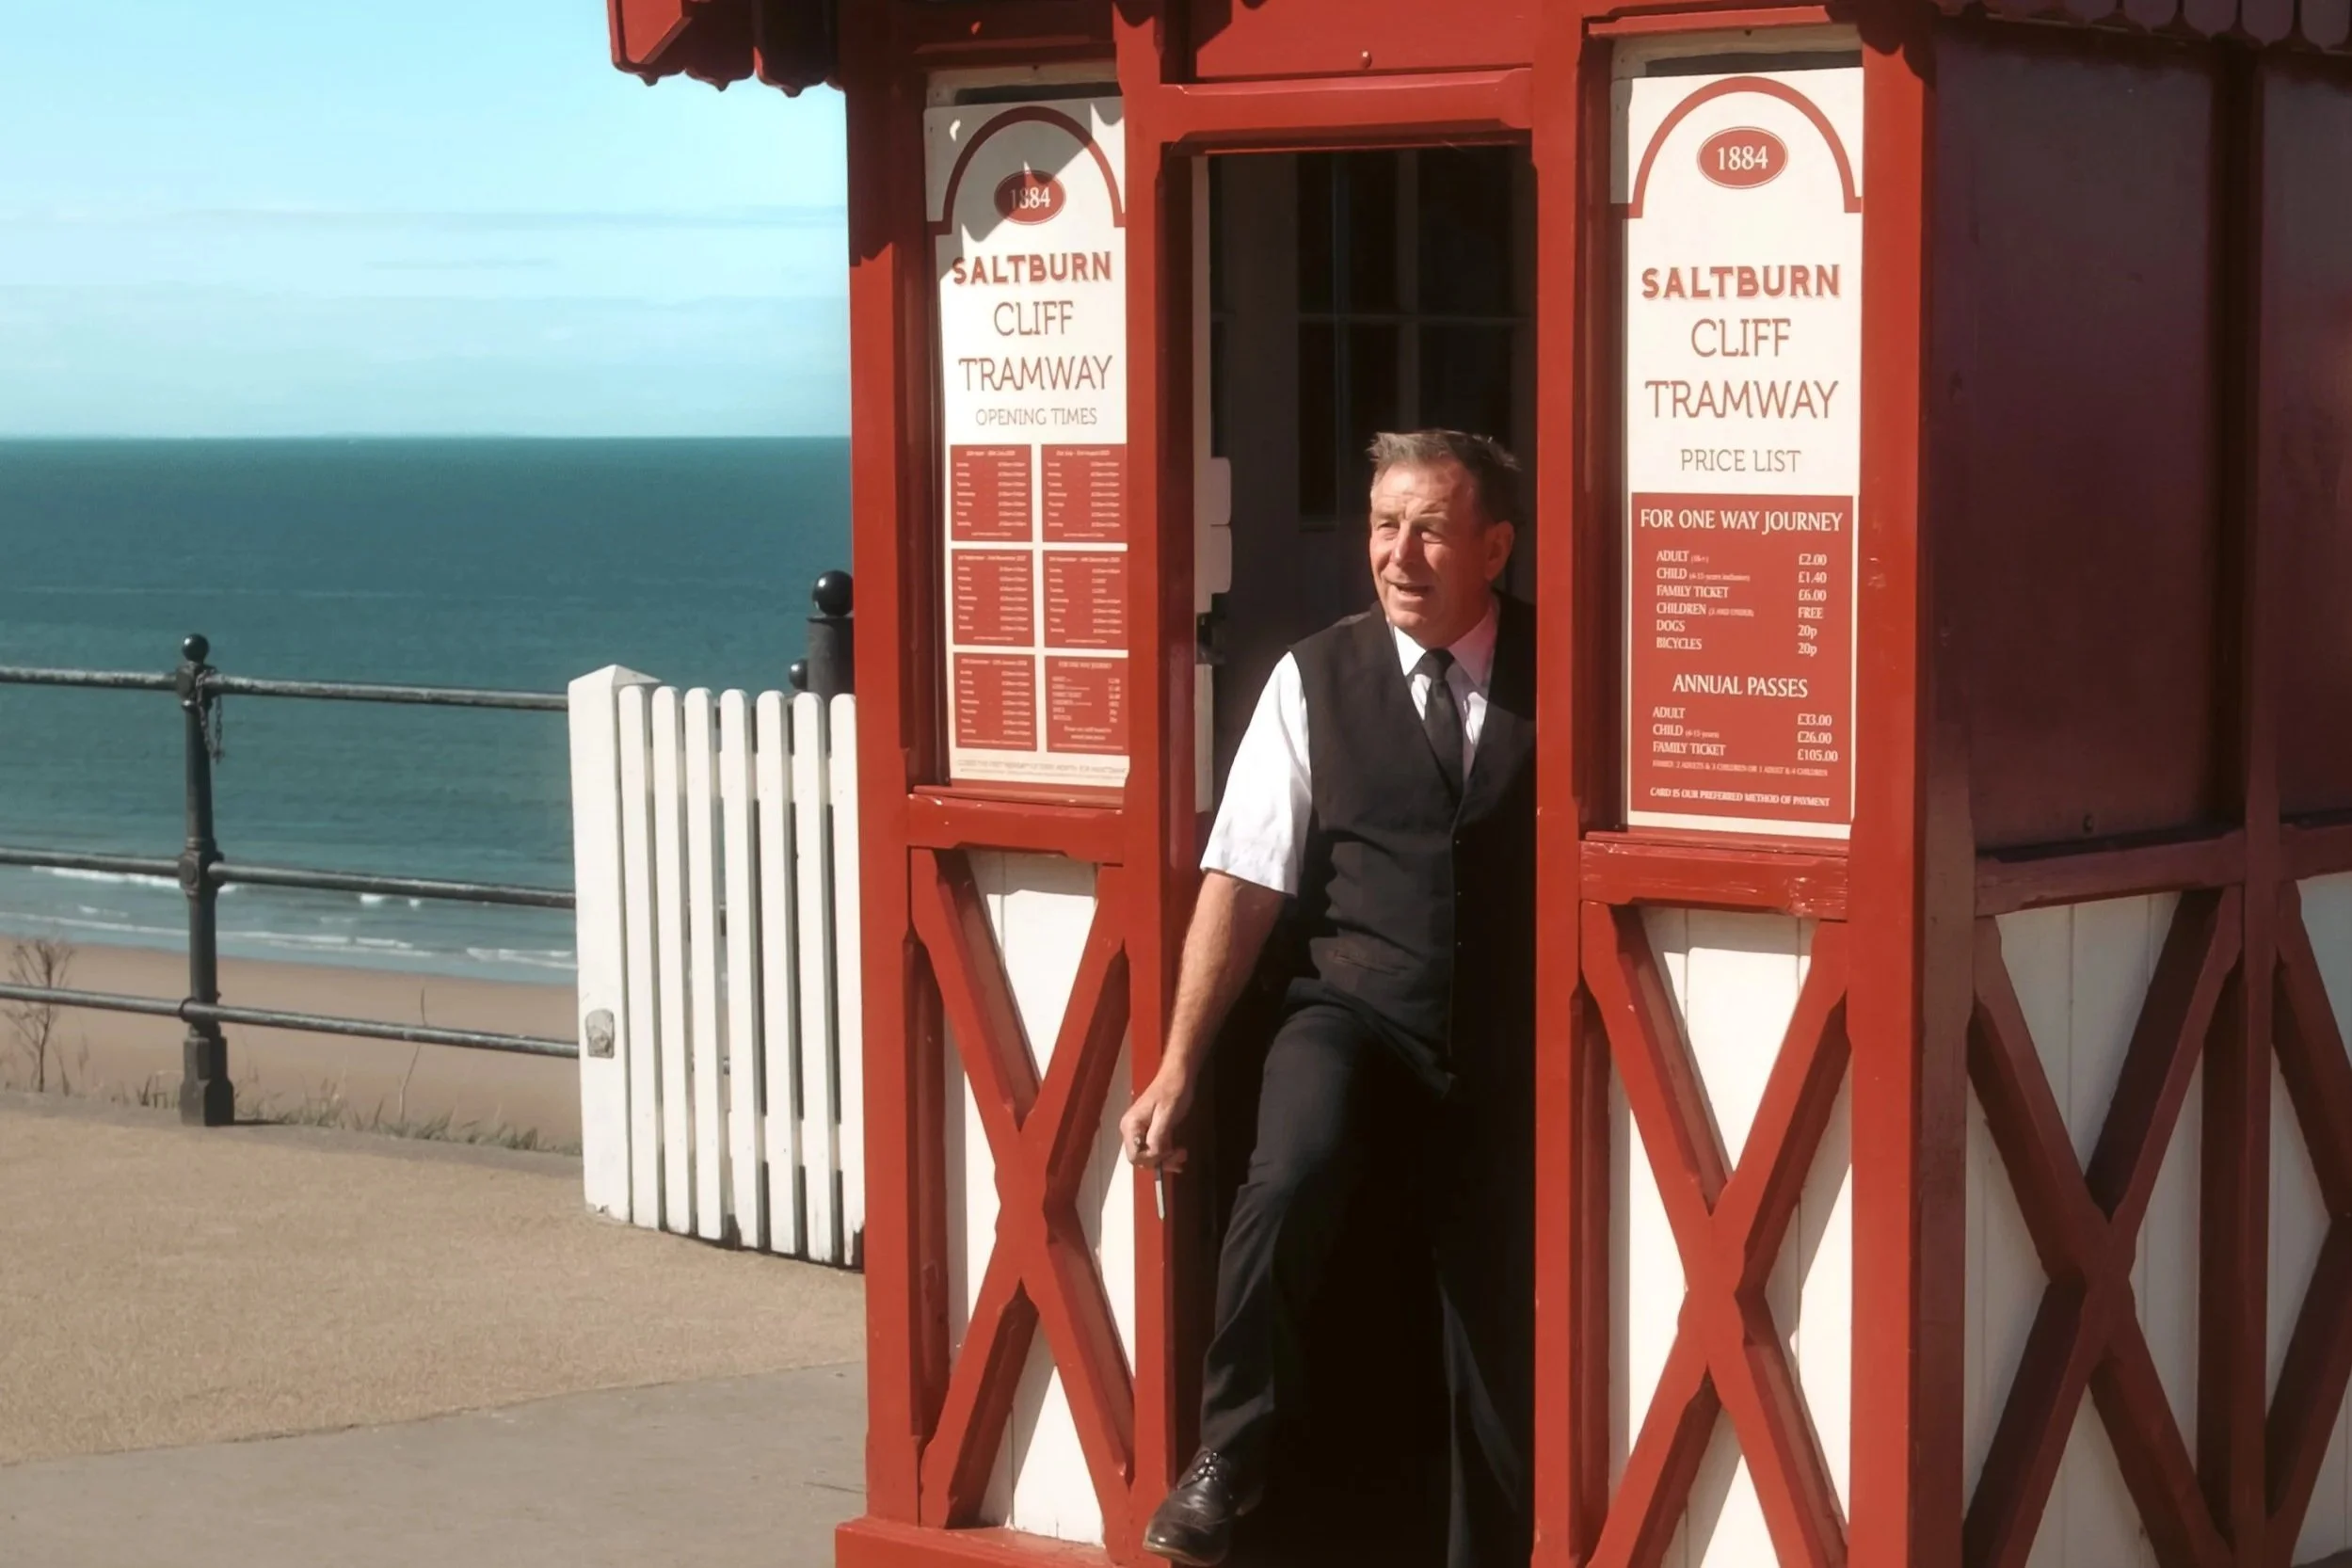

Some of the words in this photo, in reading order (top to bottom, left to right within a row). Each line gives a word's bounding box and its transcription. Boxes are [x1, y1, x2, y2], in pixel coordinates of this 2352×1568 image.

[1717, 145, 1768, 170] 1884
[1009, 186, 1051, 209] 1884
[952, 251, 1112, 285] SALTBURN
[1641, 264, 1841, 299] SALTBURN
[994, 300, 1074, 336] CLIFF
[1690, 318, 1791, 358] CLIFF
[958, 355, 1112, 392] TRAMWAY
[1645, 380, 1839, 419] TRAMWAY
[975, 408, 1047, 426] OPENING
[1050, 408, 1097, 425] TIMES
[1681, 449, 1746, 472] PRICE
[1753, 449, 1801, 472] LIST
[1640, 509, 1673, 528] FOR
[1679, 510, 1715, 529] ONE
[1720, 511, 1759, 529] WAY
[1762, 511, 1843, 535] JOURNEY
[1656, 551, 1688, 562] ADULT
[1799, 553, 1827, 566] £2.00
[1656, 568, 1687, 580] CHILD
[1799, 571, 1827, 584] £1.40
[1656, 584, 1691, 597] FAMILY
[1693, 585, 1729, 599] TICKET
[1799, 589, 1827, 601] £6.00
[1656, 601, 1706, 615] CHILDREN
[1798, 607, 1824, 619] FREE
[1656, 620, 1685, 632] DOGS
[1798, 625, 1817, 639] 20p
[1656, 638, 1702, 649] BICYCLES
[1798, 643, 1817, 656] 20p
[1672, 674, 1743, 695] ANNUAL
[1748, 677, 1808, 698] PASSES
[1653, 707, 1686, 719] ADULT
[1797, 713, 1832, 727] £33.00
[1653, 724, 1684, 736] CHILD
[1797, 730, 1832, 744] £26.00
[1653, 742, 1688, 754] FAMILY
[1688, 744, 1726, 756] TICKET
[1797, 748, 1838, 762] £105.00
